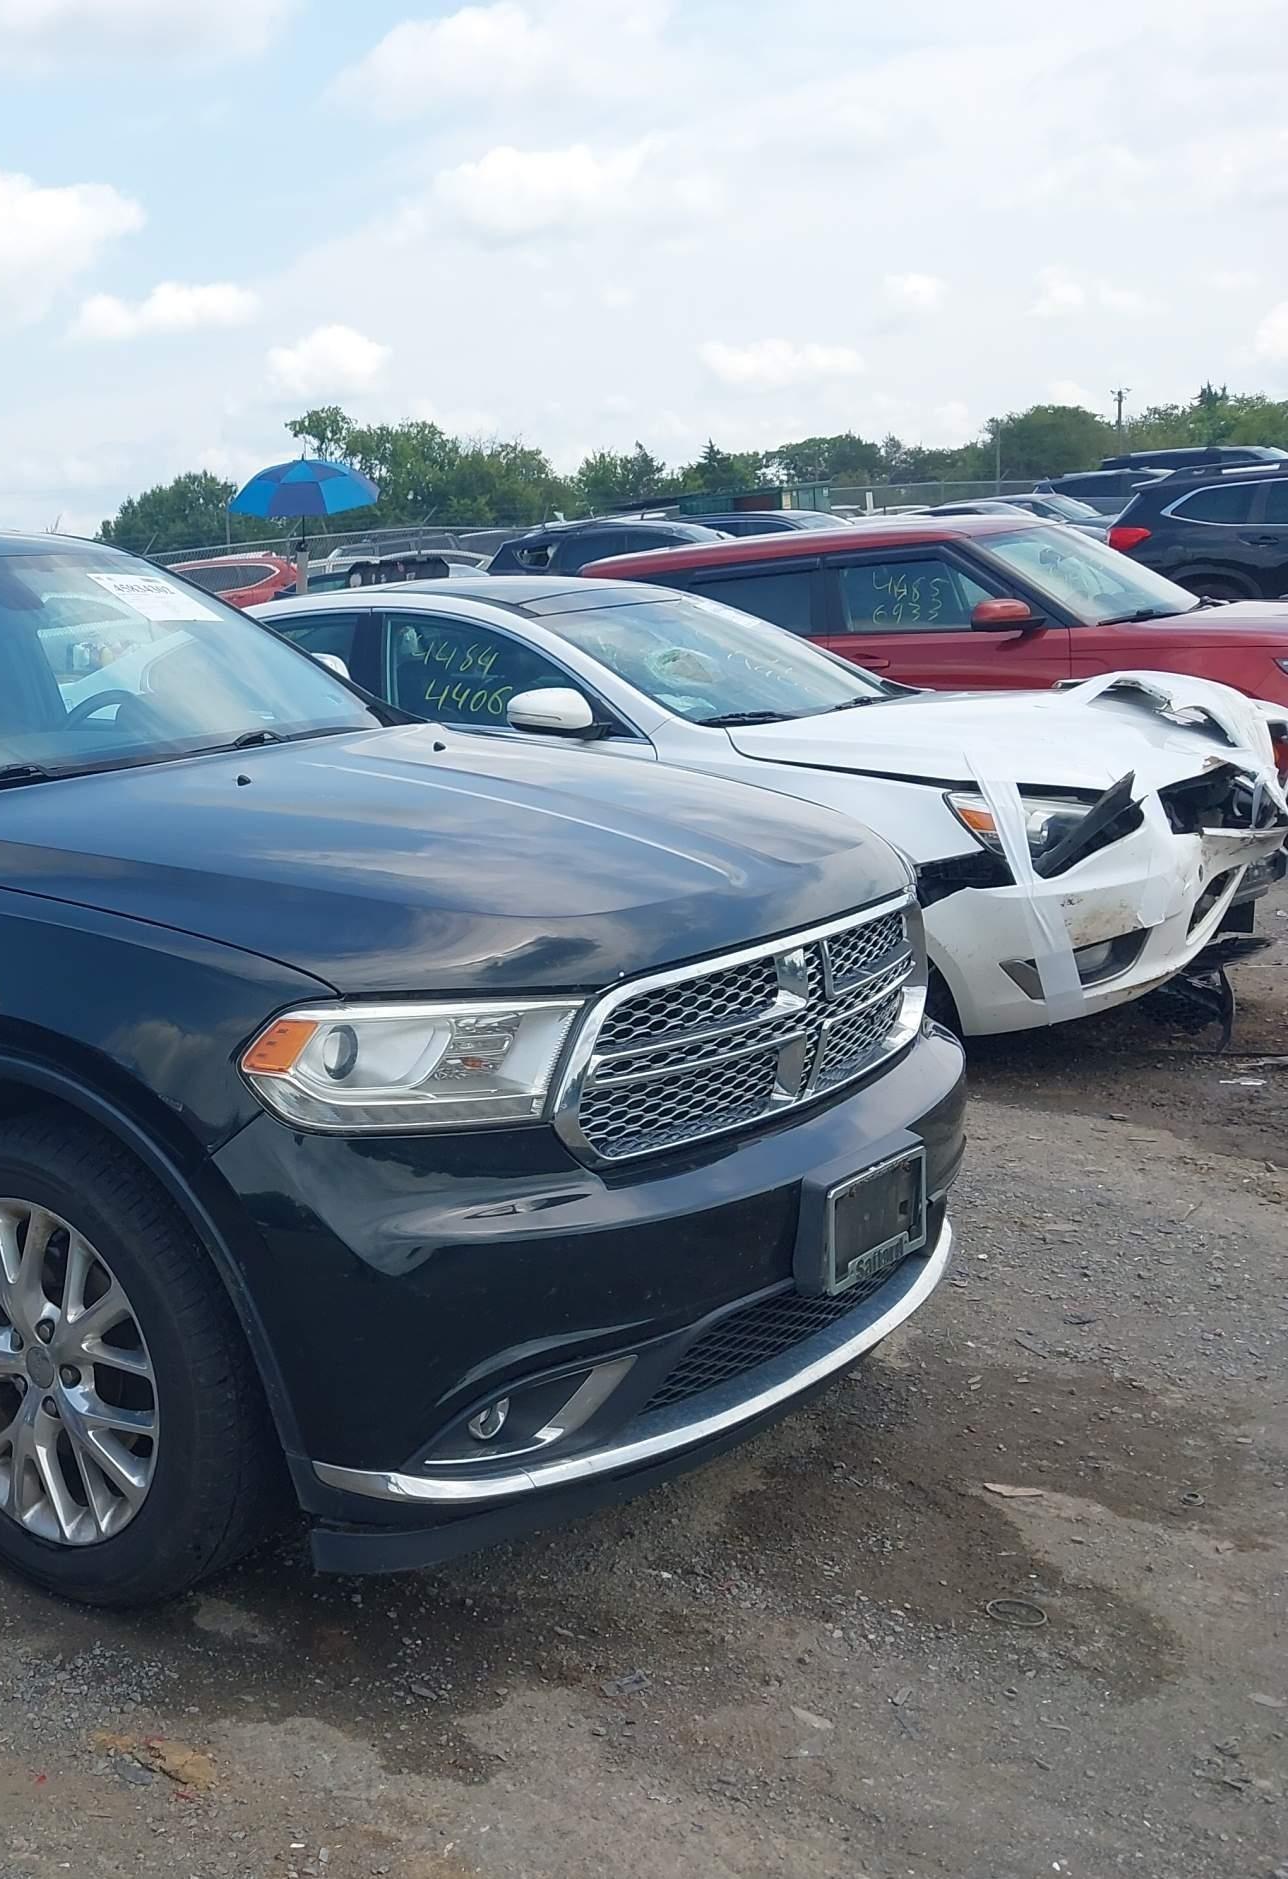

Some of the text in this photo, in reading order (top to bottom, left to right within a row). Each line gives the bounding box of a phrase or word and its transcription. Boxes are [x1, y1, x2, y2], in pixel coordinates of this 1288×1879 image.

[872, 598, 943, 624] 6933
[412, 634, 500, 679] 4484
[424, 679, 513, 715] 4406
